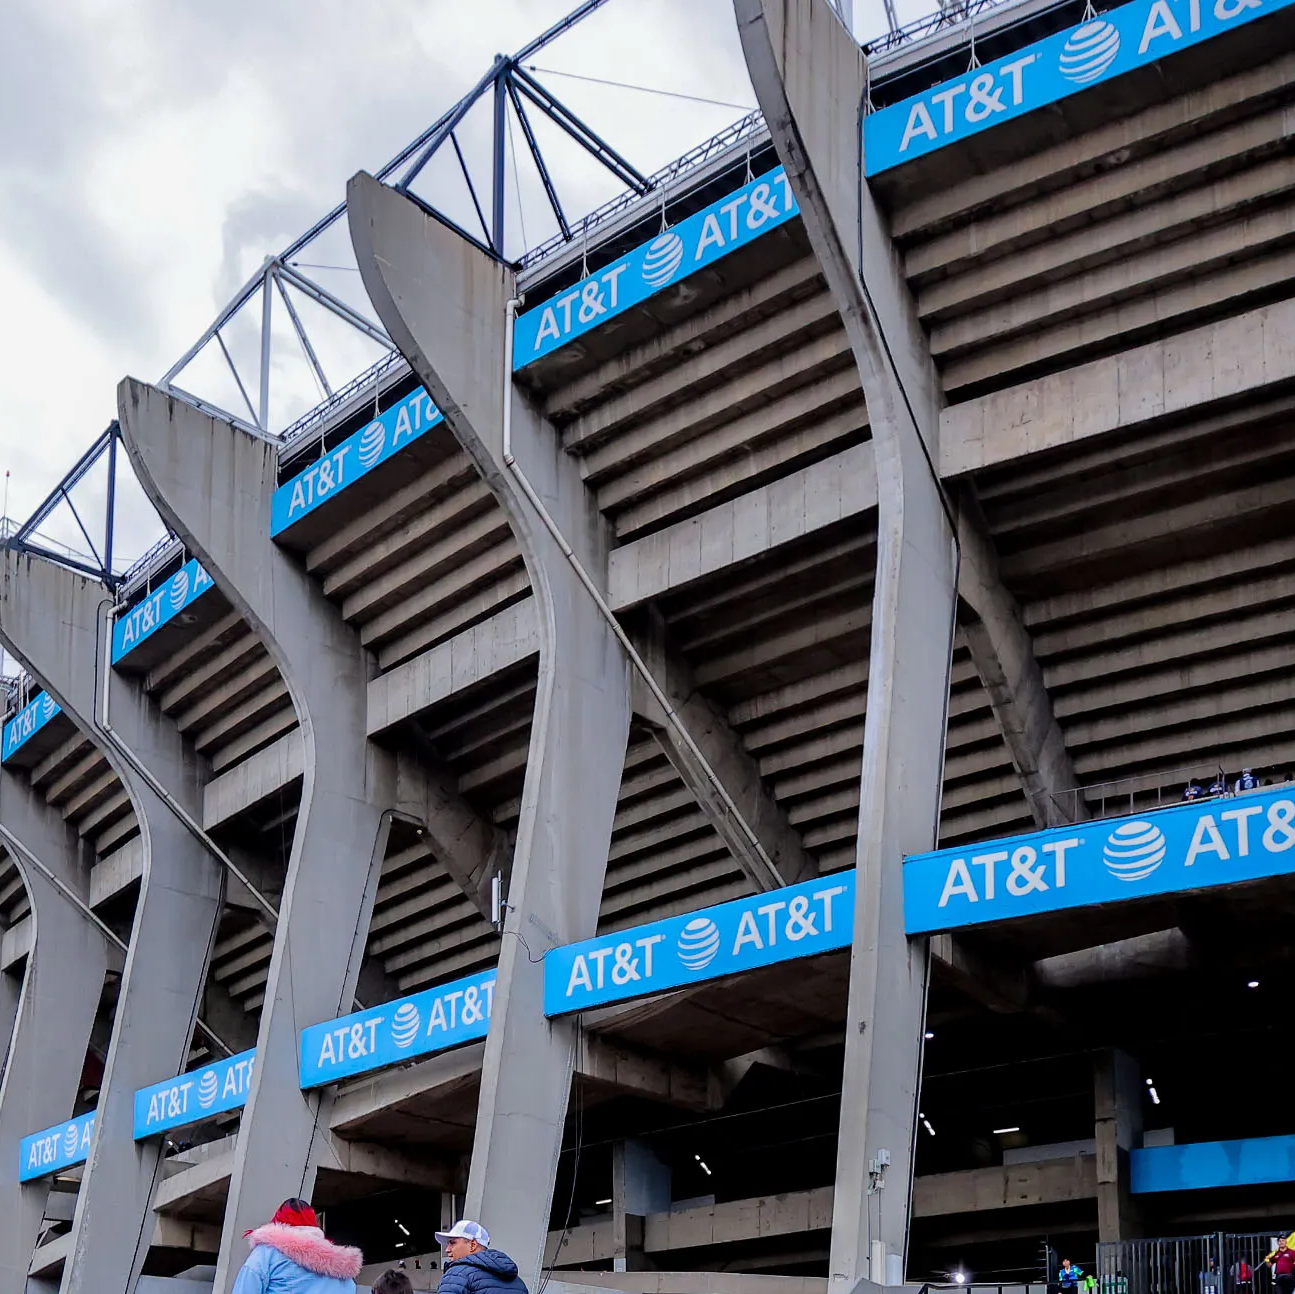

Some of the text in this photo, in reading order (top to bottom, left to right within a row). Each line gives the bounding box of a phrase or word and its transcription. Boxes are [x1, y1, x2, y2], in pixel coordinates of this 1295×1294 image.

[899, 53, 1037, 153] AT&T
[534, 264, 627, 351] AT&T
[288, 446, 350, 518] AT&T
[122, 590, 166, 650] AT&T
[9, 701, 40, 750] AT&T
[937, 838, 1079, 908] AT&T
[565, 885, 844, 997] AT&T AT&T
[317, 979, 496, 1068] AT&T AT&T
[146, 1082, 193, 1126] AT&T
[28, 1133, 60, 1170] AT&T
